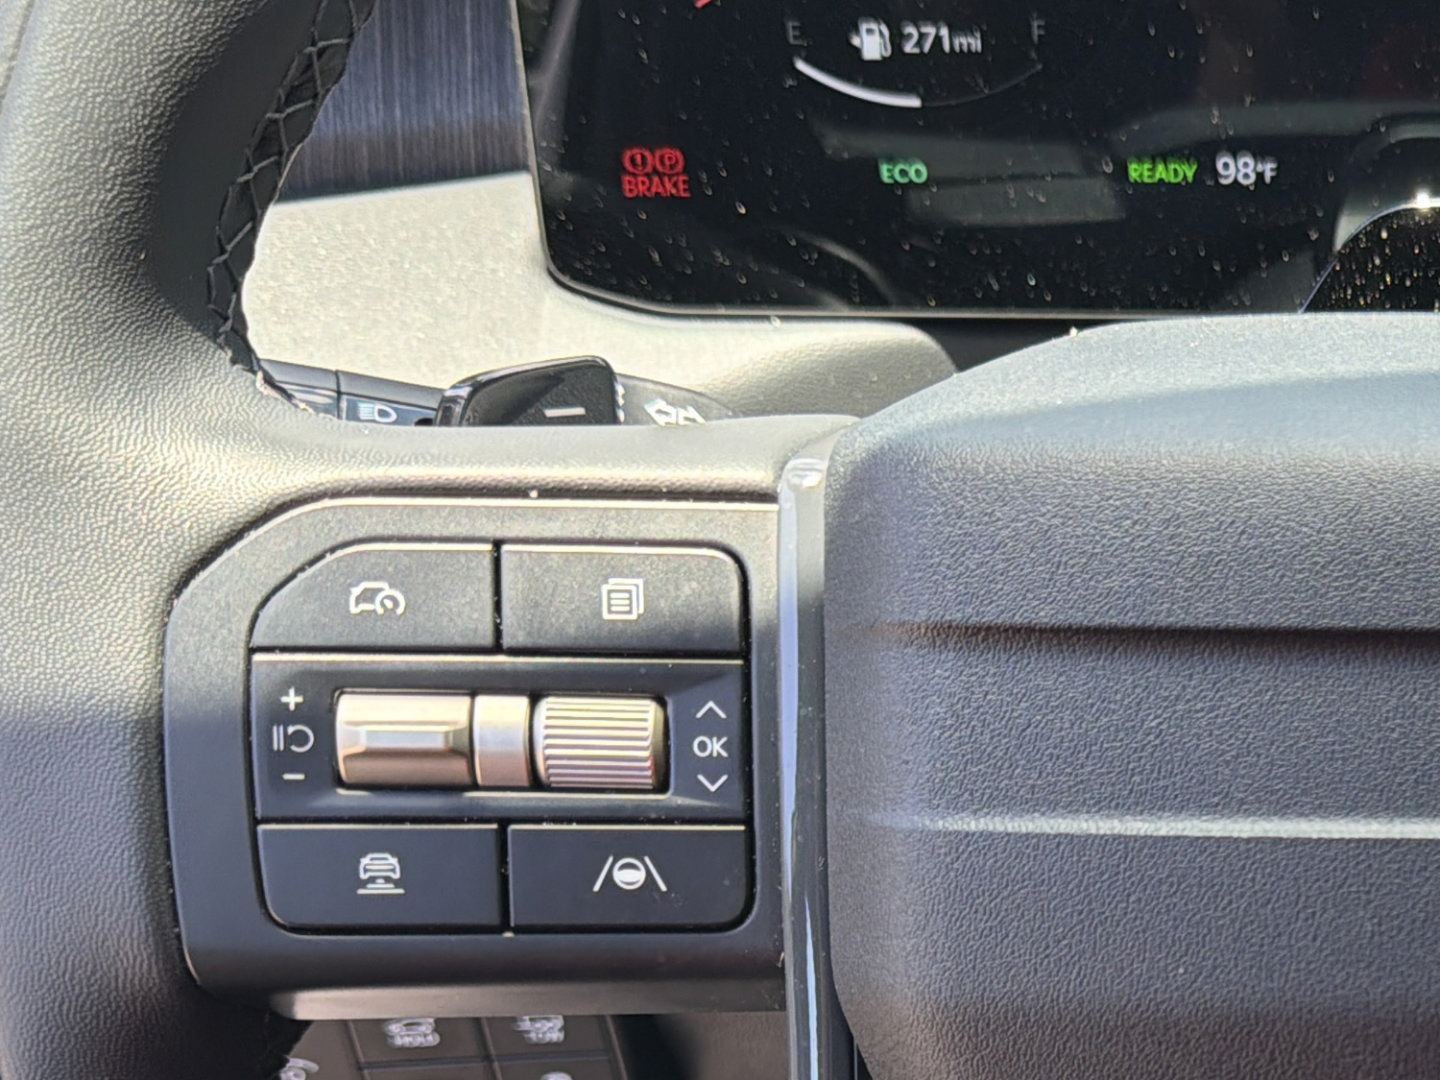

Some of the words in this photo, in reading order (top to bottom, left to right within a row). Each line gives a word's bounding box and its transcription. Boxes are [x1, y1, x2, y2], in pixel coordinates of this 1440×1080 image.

[880, 160, 927, 183] ECO
[1128, 160, 1197, 183] READY
[621, 174, 691, 198] BRAKE
[693, 736, 727, 757] OK
